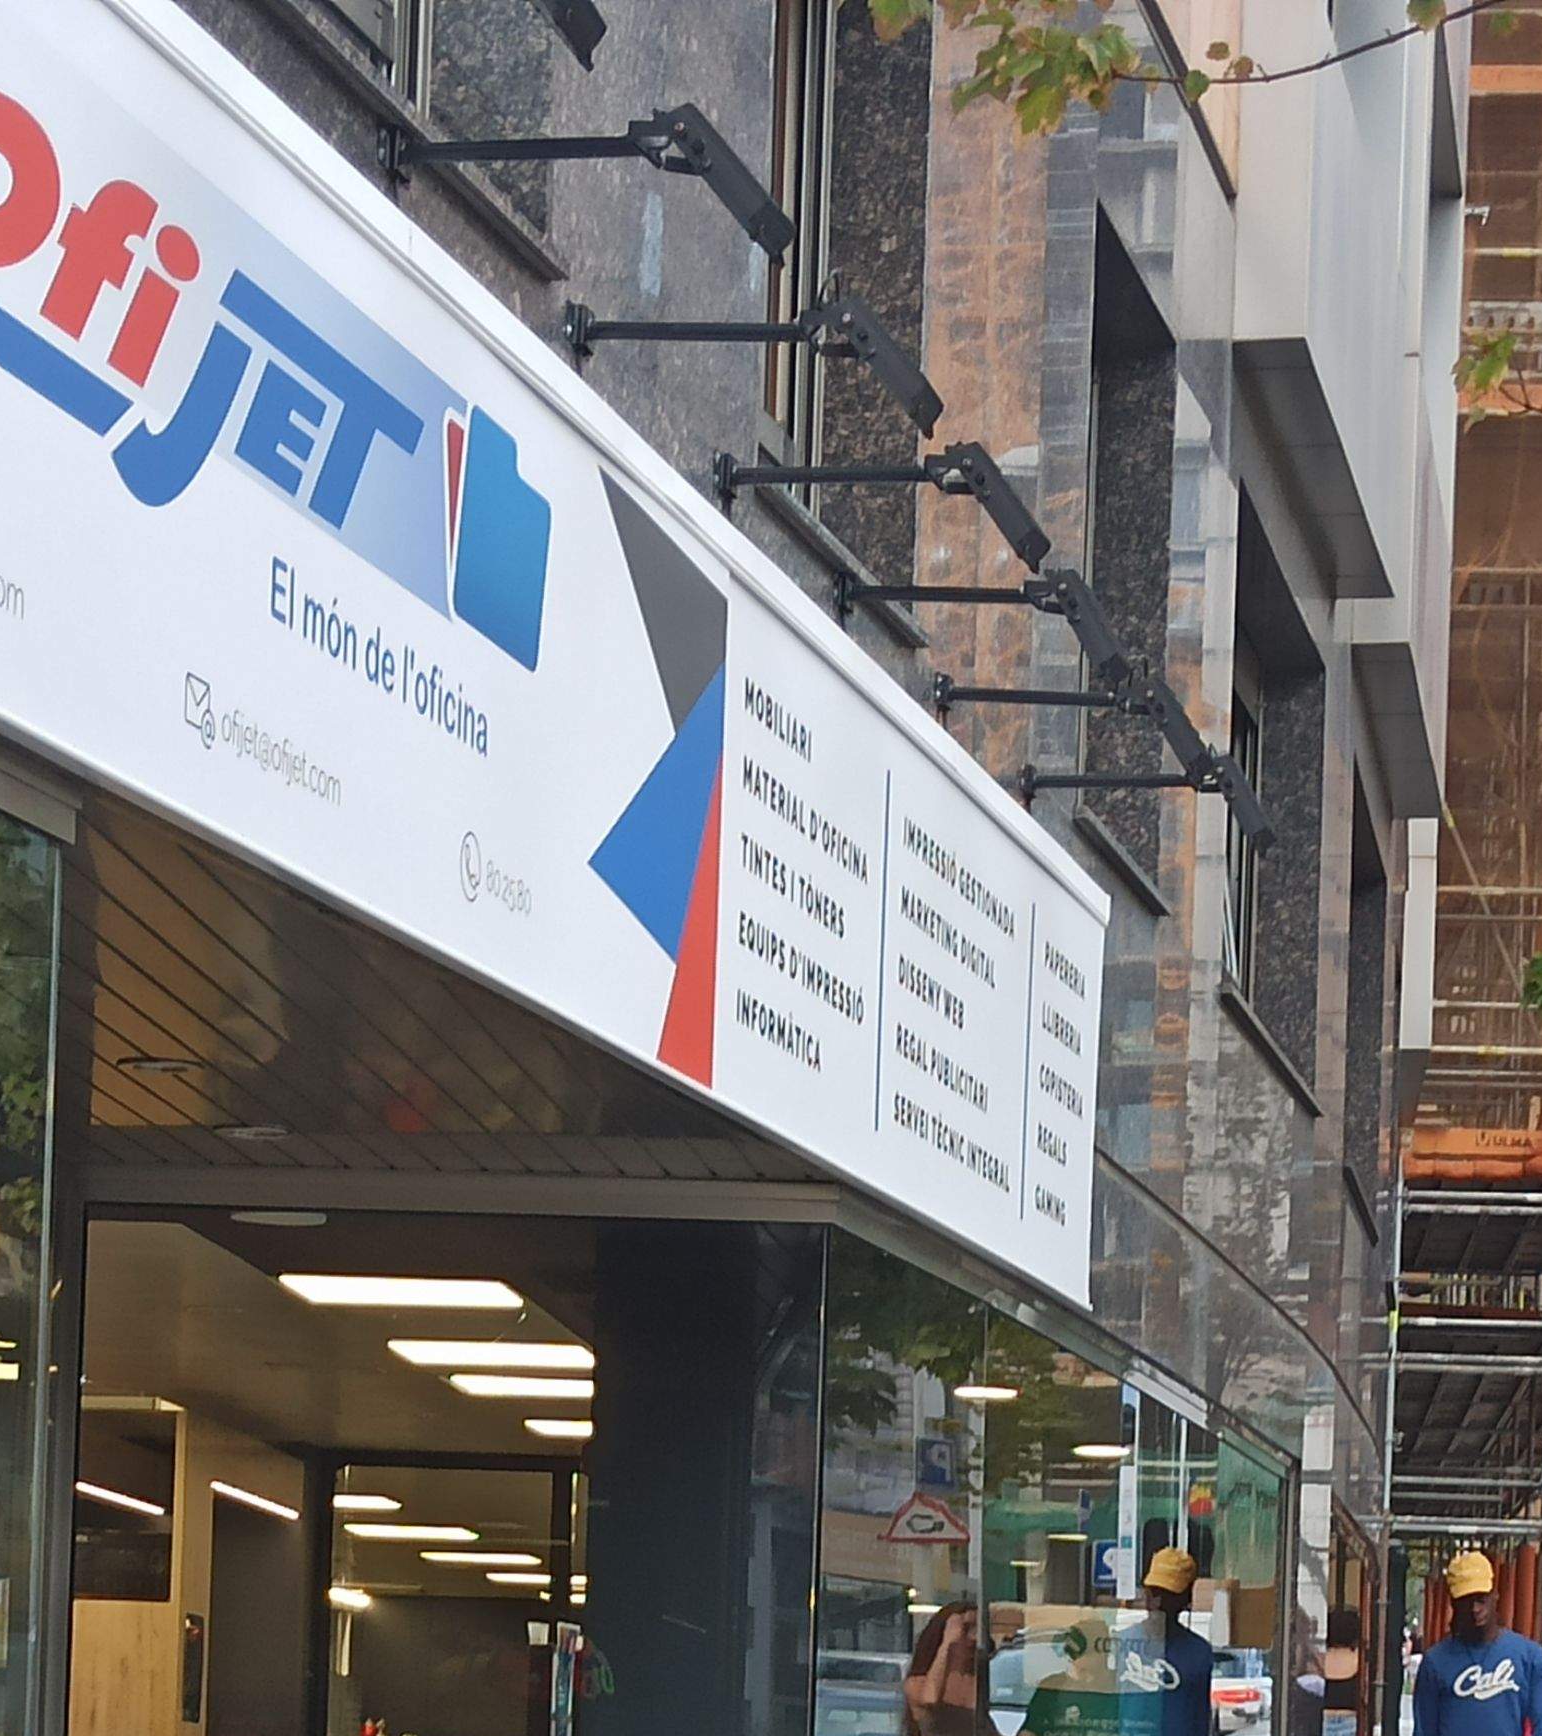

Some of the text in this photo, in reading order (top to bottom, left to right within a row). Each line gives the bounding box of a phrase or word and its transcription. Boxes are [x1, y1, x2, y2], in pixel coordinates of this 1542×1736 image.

[270, 555, 489, 757] El món de l'oficina
[221, 709, 342, 806] ofijet@ofijet.com
[745, 677, 812, 763] MOBILIARI
[742, 755, 868, 885] MATERIAL D'OFICINA
[741, 834, 786, 897] TINTES
[790, 869, 796, 903] I
[903, 816, 1016, 941] IMPRESSIÓ GESTIONADA
[738, 910, 864, 1026] EQUIPS D'IMPRESSIÓ
[900, 885, 997, 990] MARKETING DIGITAL
[1044, 940, 1086, 1001] PAPERERIA
[898, 953, 965, 1030] DISSENY WEB
[1042, 1001, 1082, 1057] LLIBRERIA
[896, 1022, 989, 1114] REGAL PUBLICITARI
[1039, 1062, 1084, 1120] COPISTERIA
[893, 1090, 929, 1146] SERVEI
[966, 1141, 1010, 1193] INTEGRAL
[1036, 1122, 1068, 1168] REGALS
[1034, 1183, 1067, 1228] GAMING
